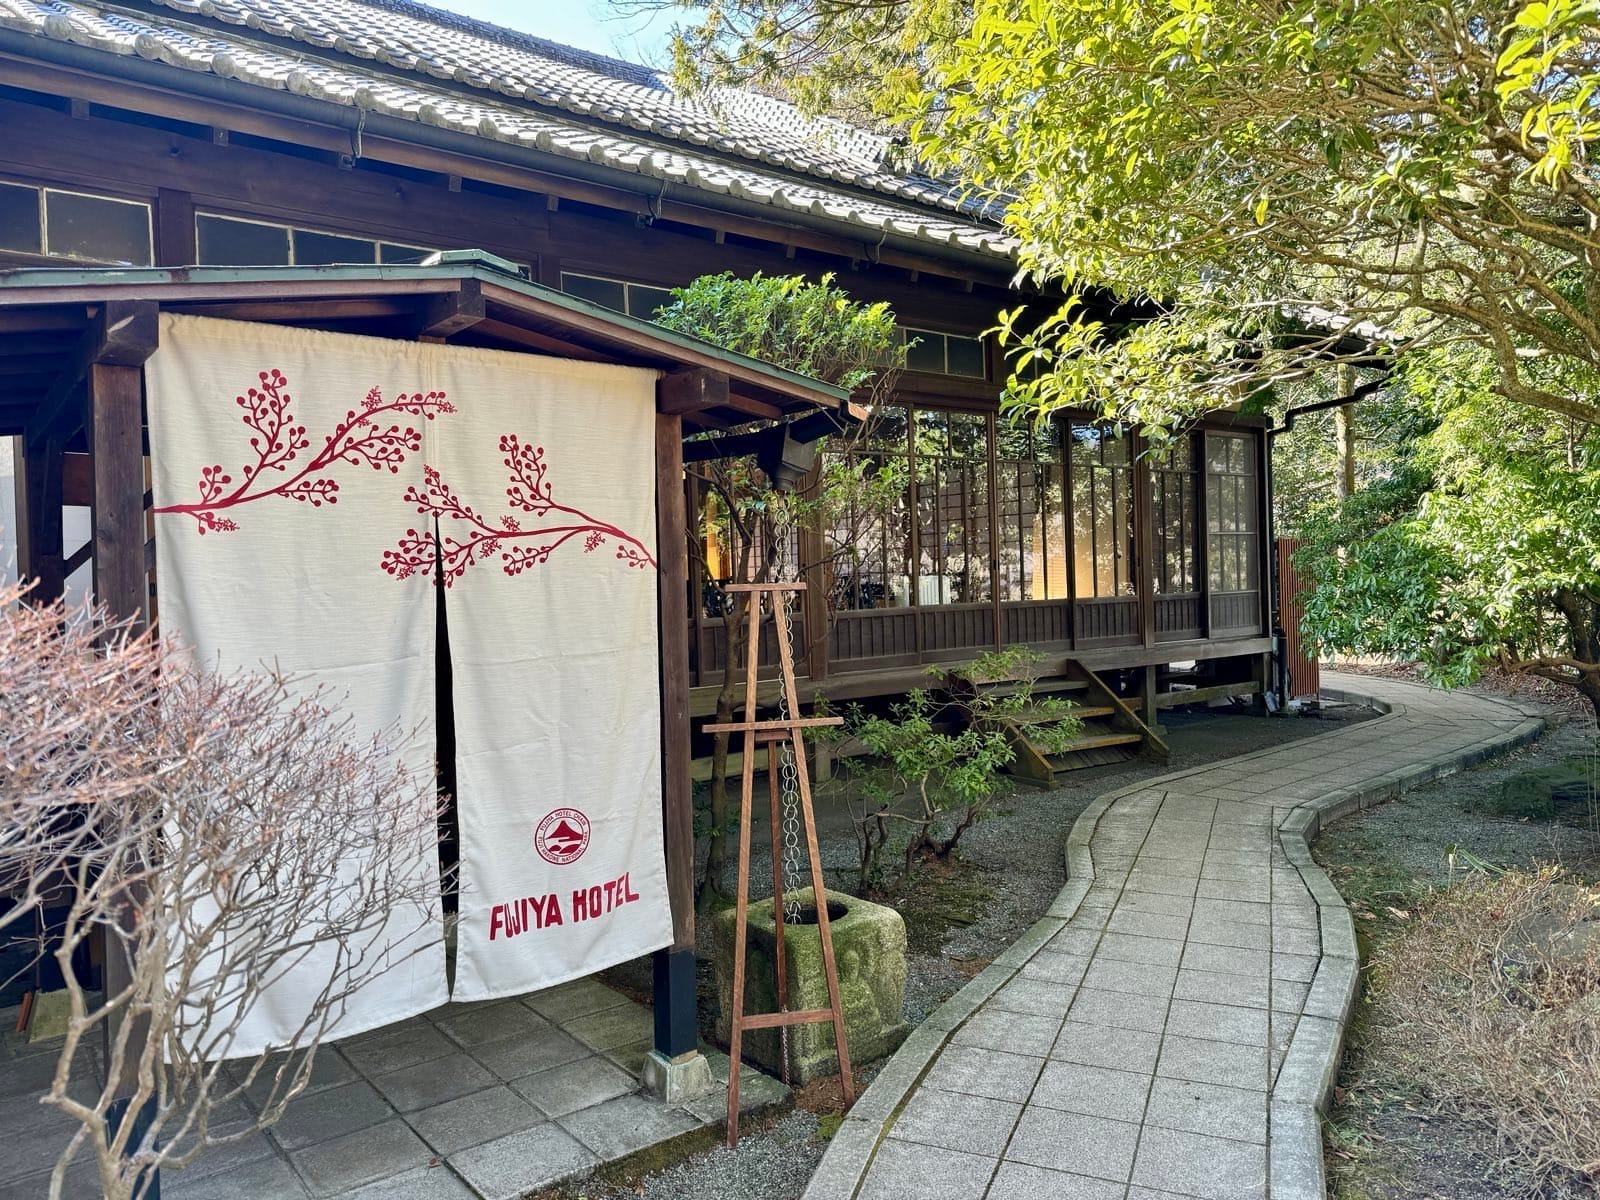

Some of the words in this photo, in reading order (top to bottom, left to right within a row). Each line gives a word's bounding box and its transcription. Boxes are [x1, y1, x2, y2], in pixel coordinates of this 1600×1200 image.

[540, 815, 554, 831] FUJIYA
[573, 813, 587, 826] CHAIN
[542, 848, 560, 862] HAKONE
[561, 846, 585, 863] NATIONAL
[489, 893, 563, 941] FUJIYA
[572, 872, 640, 923] HOTEL
